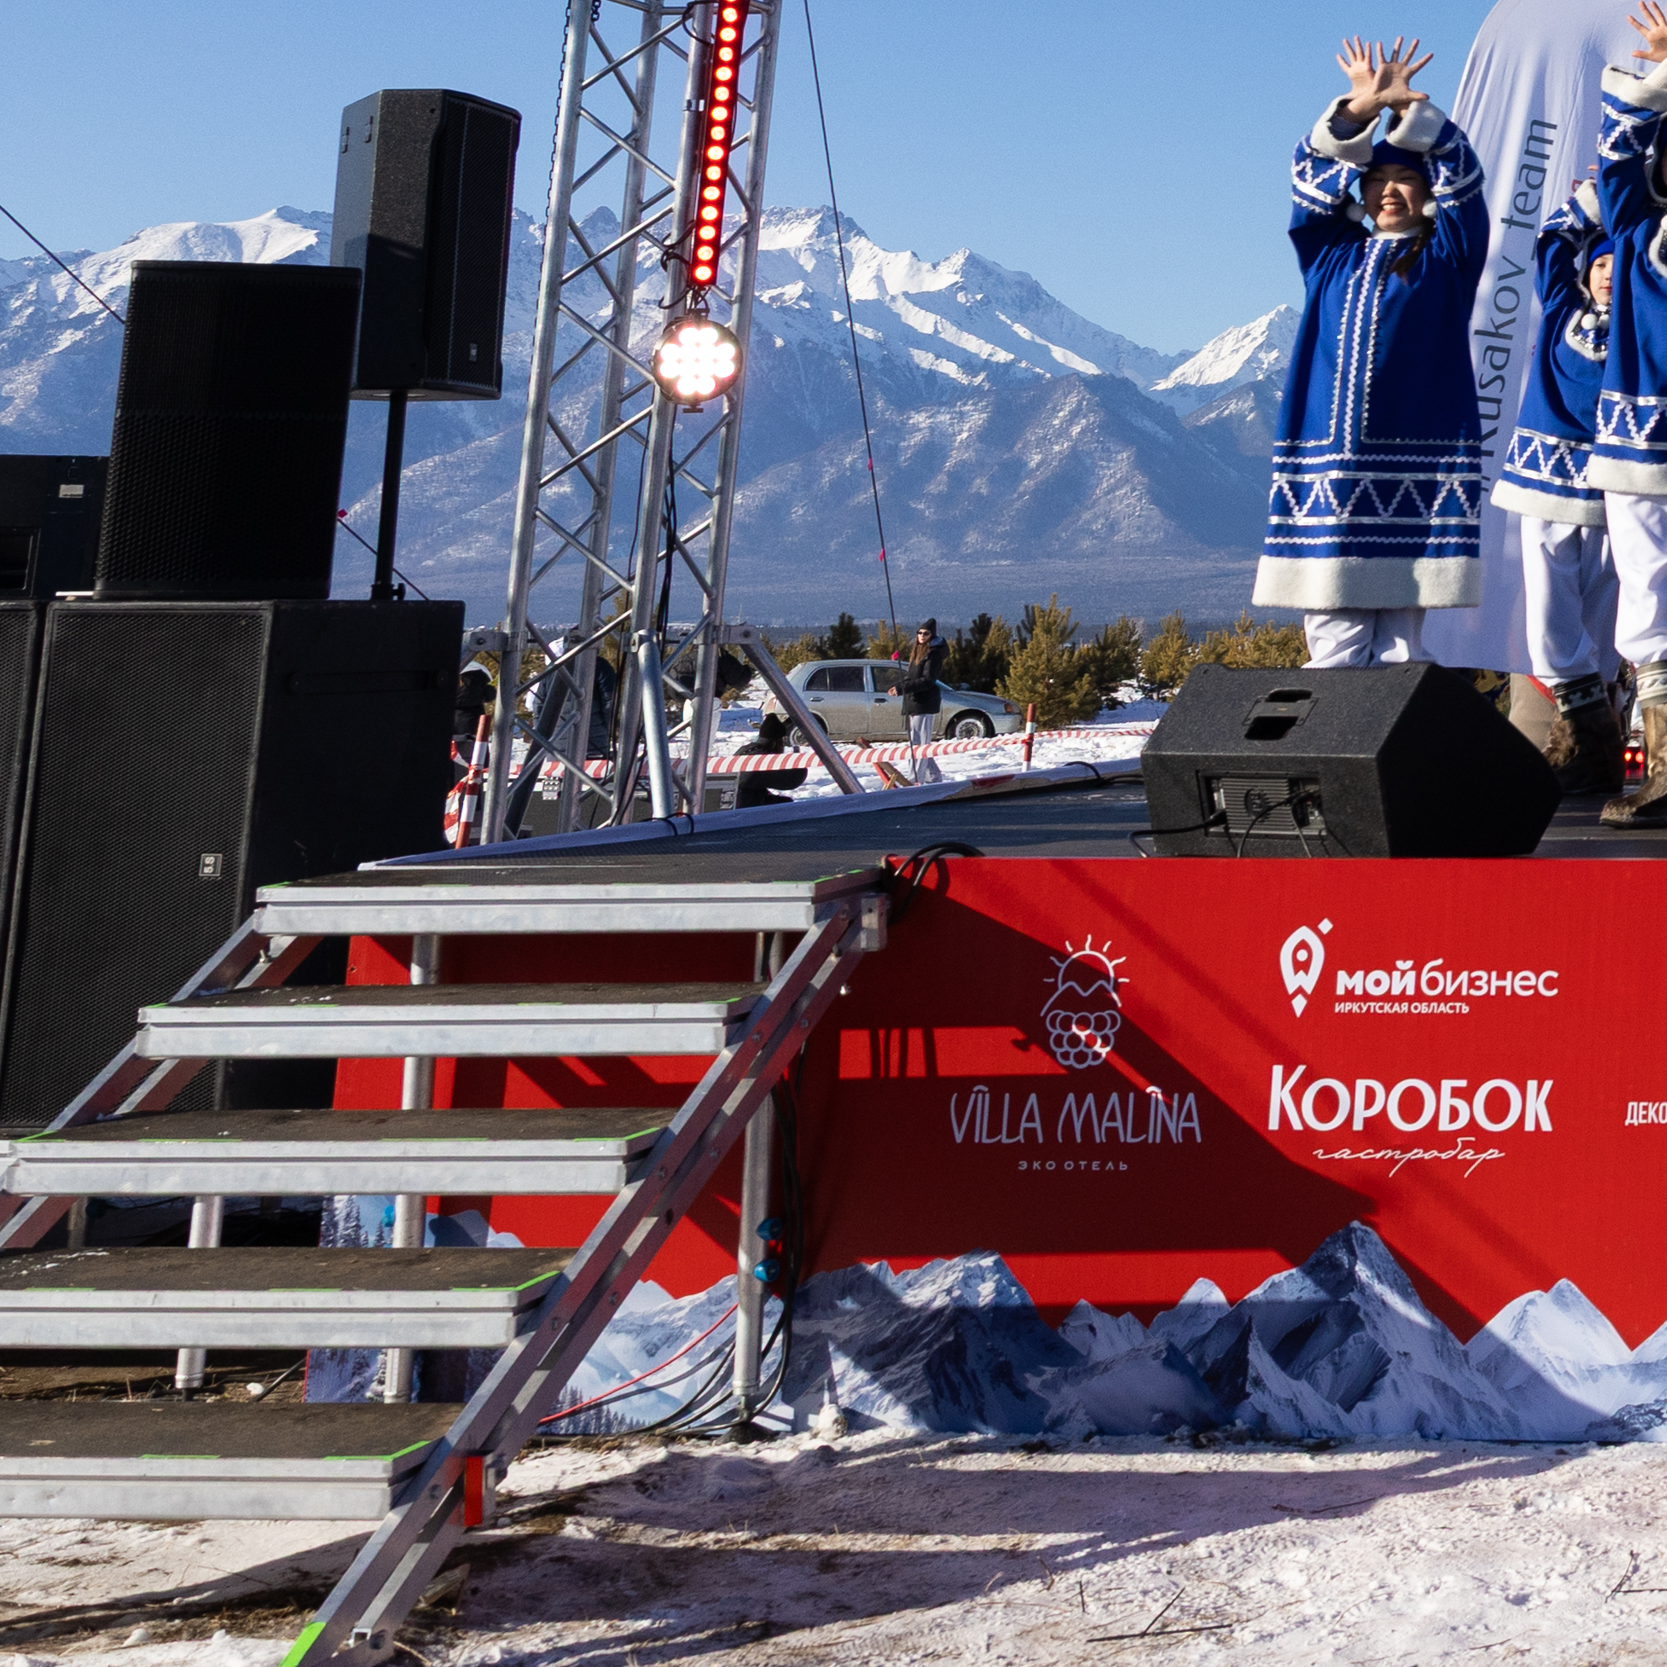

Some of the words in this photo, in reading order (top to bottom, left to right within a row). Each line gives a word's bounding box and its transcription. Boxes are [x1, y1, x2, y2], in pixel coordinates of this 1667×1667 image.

[1335, 1001, 1409, 1014] ИРКУТСКАЯ
[1411, 1002, 1470, 1014] ОБЛАСТЬ
[1313, 1137, 1505, 1178] гастробар
[1018, 1161, 1056, 1171] ЭКО
[1064, 1161, 1128, 1171] ОТЕЛЬ
